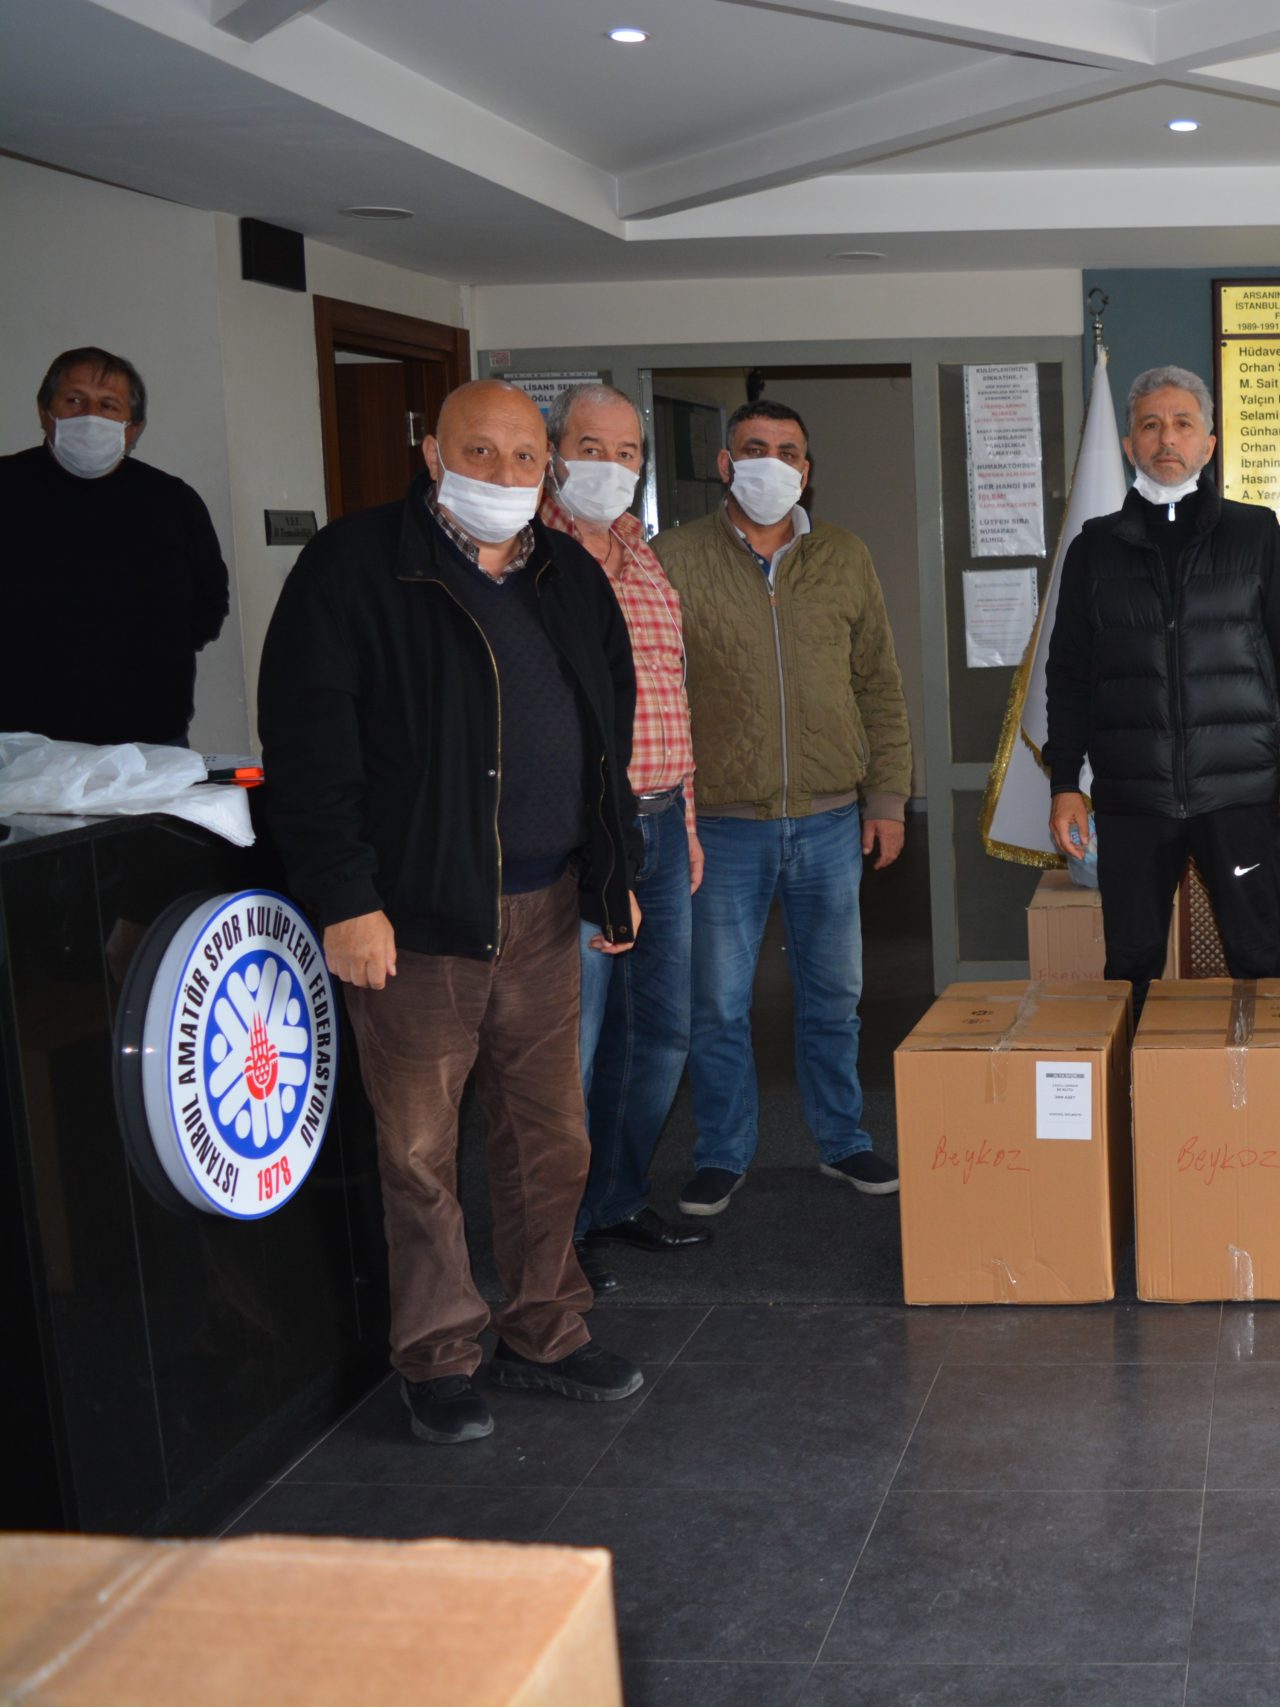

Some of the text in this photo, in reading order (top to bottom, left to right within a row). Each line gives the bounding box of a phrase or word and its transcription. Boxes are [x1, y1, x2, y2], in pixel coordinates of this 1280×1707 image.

[1240, 363, 1274, 372] Orhan
[1240, 379, 1252, 388] M.
[1257, 379, 1278, 388] Sait
[1240, 395, 1274, 406] Yalçın
[1240, 411, 1279, 420] Selami
[1241, 442, 1276, 452] Orhan
[1242, 474, 1277, 484] Hasan
[1242, 491, 1252, 499] A.
[178, 906, 331, 1203] İSTANBUL AMATÖR SPOR KULÜPLERİ FEDERASYONU
[257, 1156, 292, 1201] 1978
